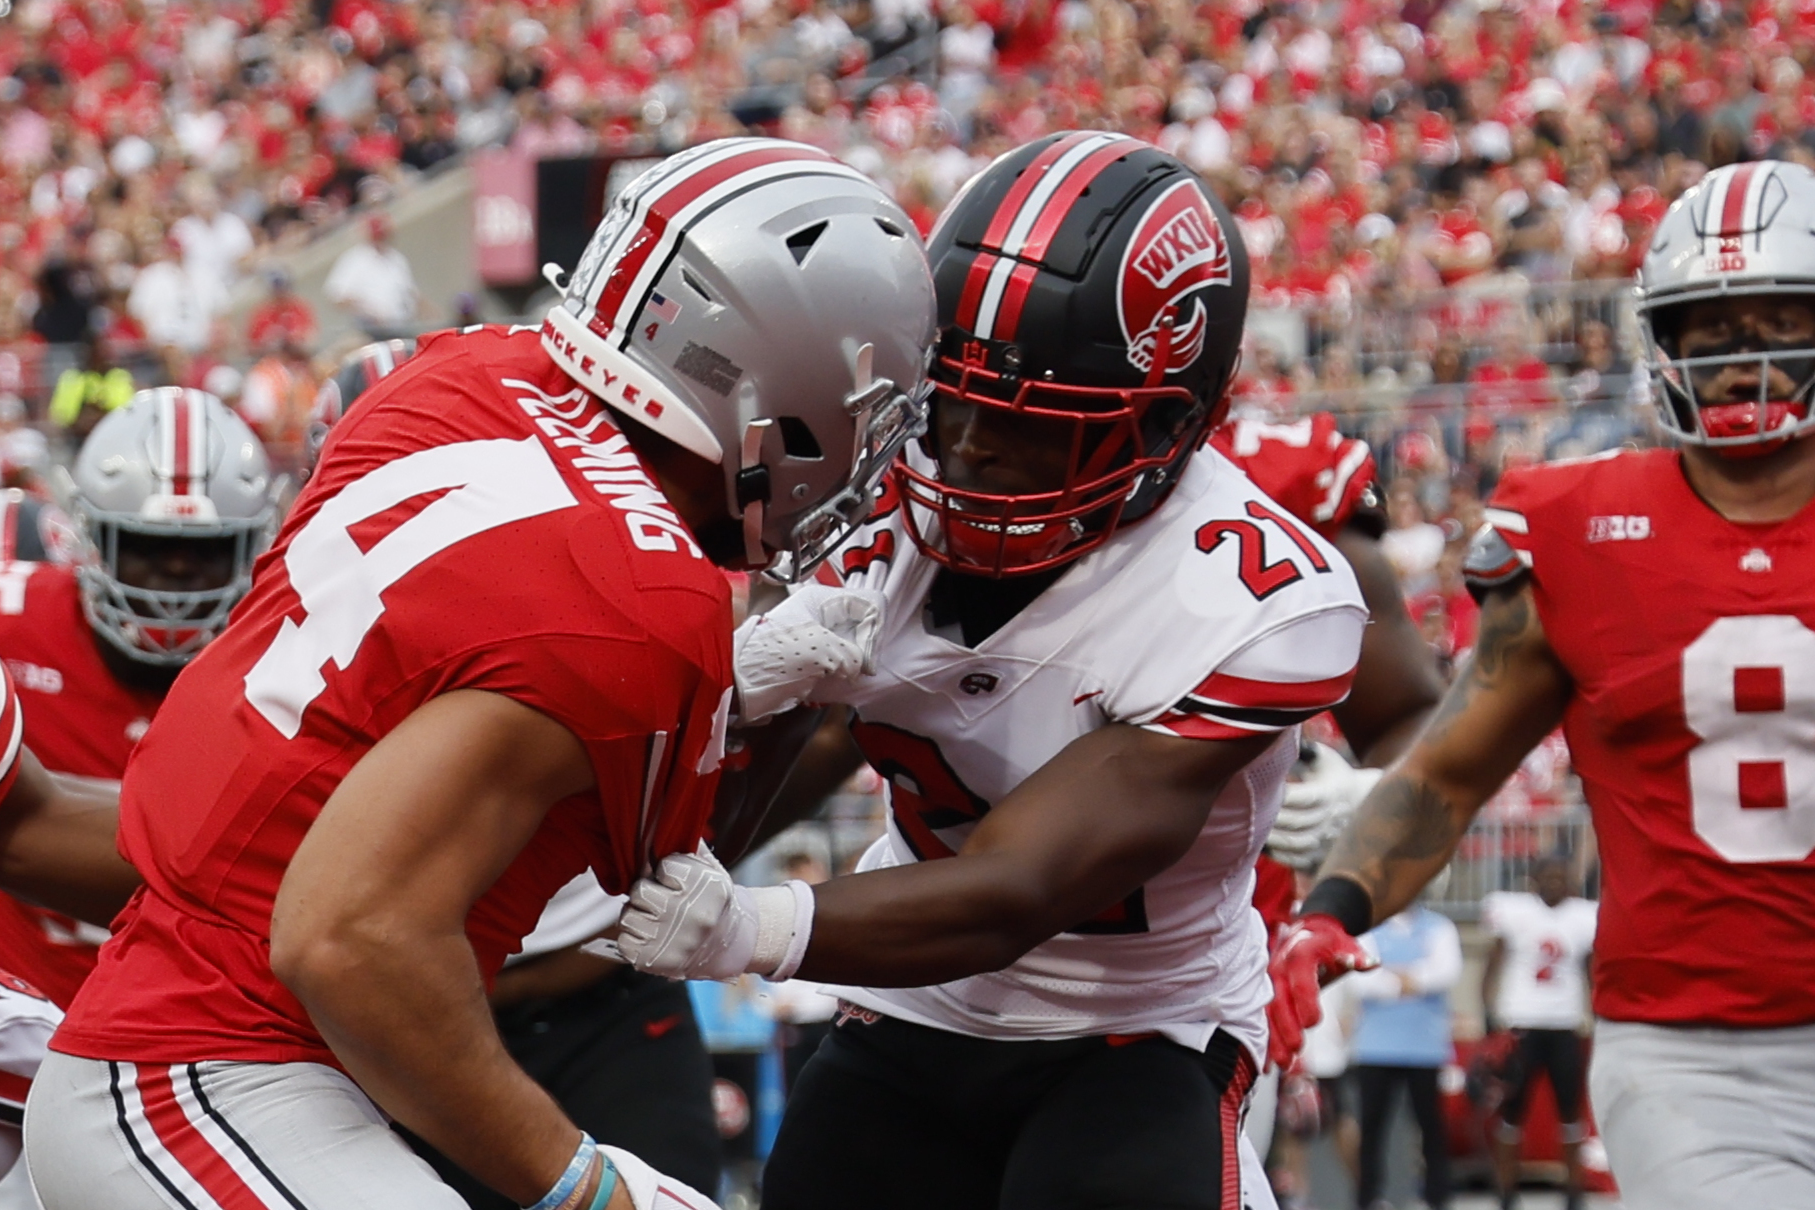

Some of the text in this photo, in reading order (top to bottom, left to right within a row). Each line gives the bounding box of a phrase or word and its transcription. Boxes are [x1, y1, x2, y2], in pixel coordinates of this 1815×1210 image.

[1137, 211, 1212, 281] WKU
[644, 321, 659, 341] 4
[244, 433, 580, 740] 4
[1195, 500, 1332, 602] 21
[1680, 614, 1815, 864] 8
